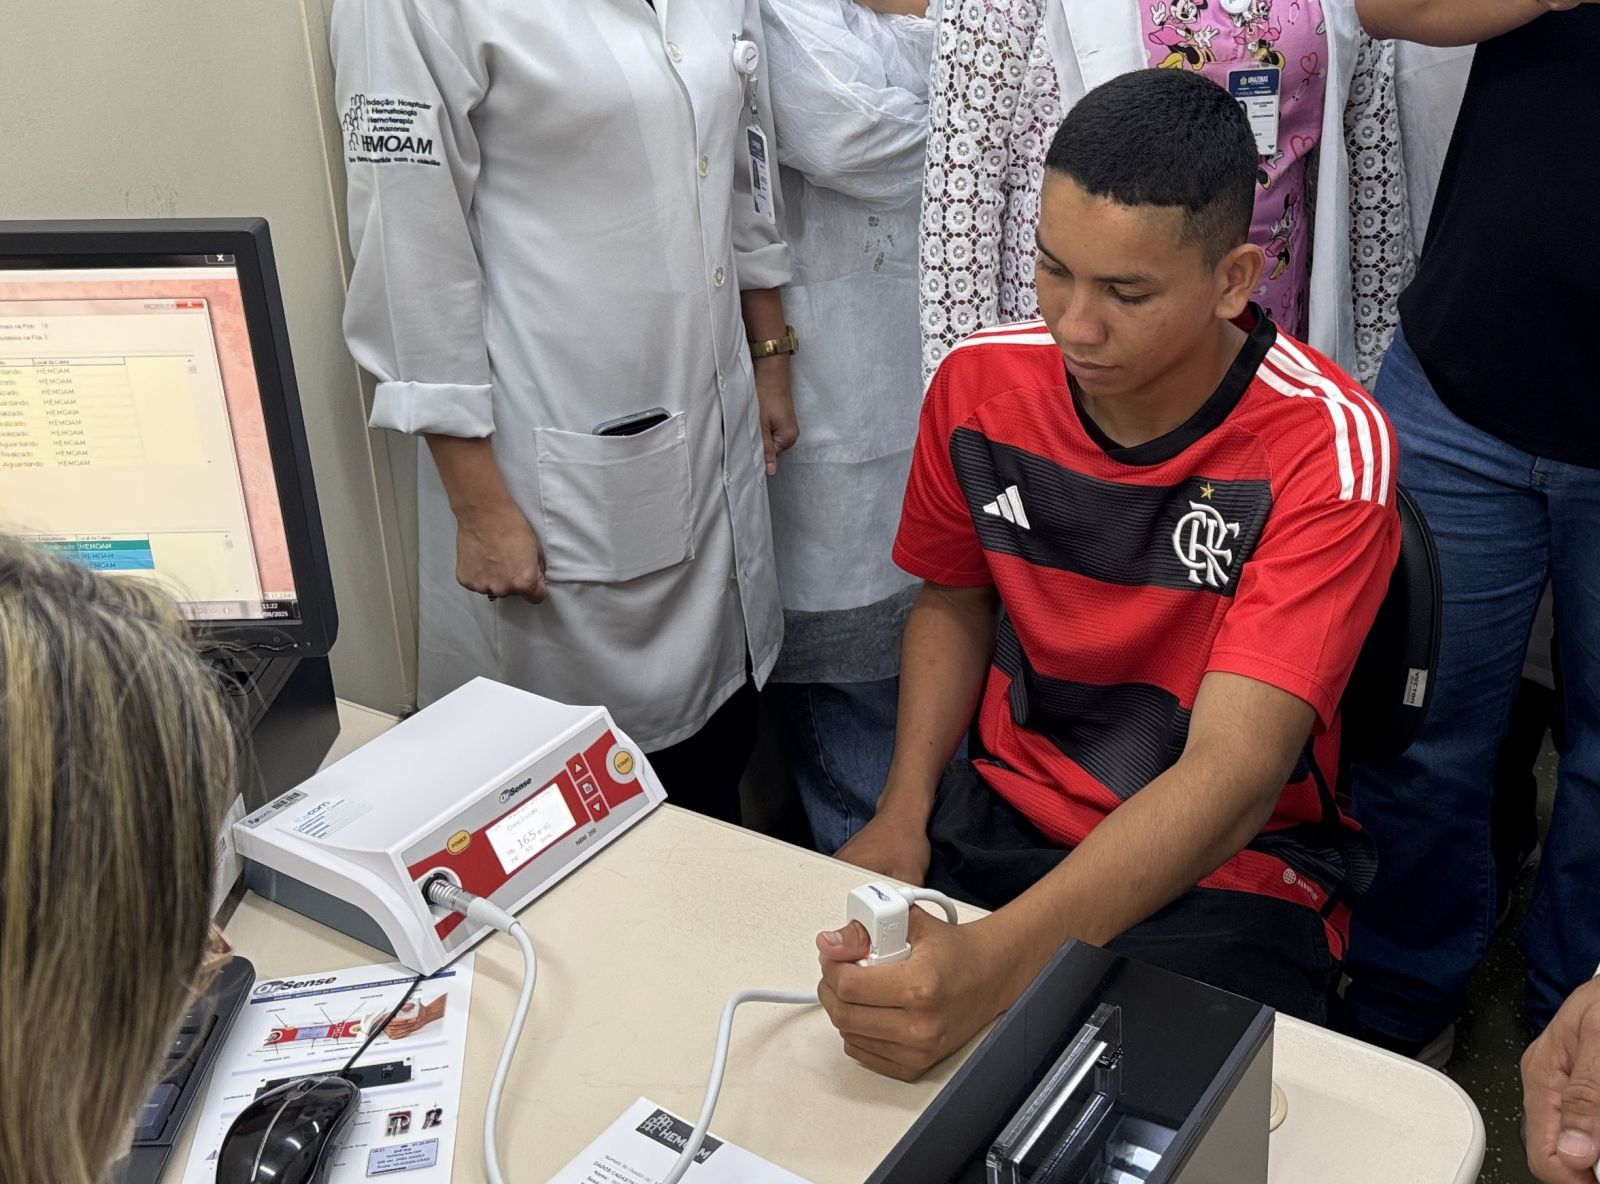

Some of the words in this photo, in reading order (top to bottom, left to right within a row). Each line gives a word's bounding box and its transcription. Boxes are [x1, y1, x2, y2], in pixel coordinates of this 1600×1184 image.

[500, 778, 532, 804] OrSense
[253, 977, 336, 995] OrSense
[659, 1129, 712, 1159] HEMM
